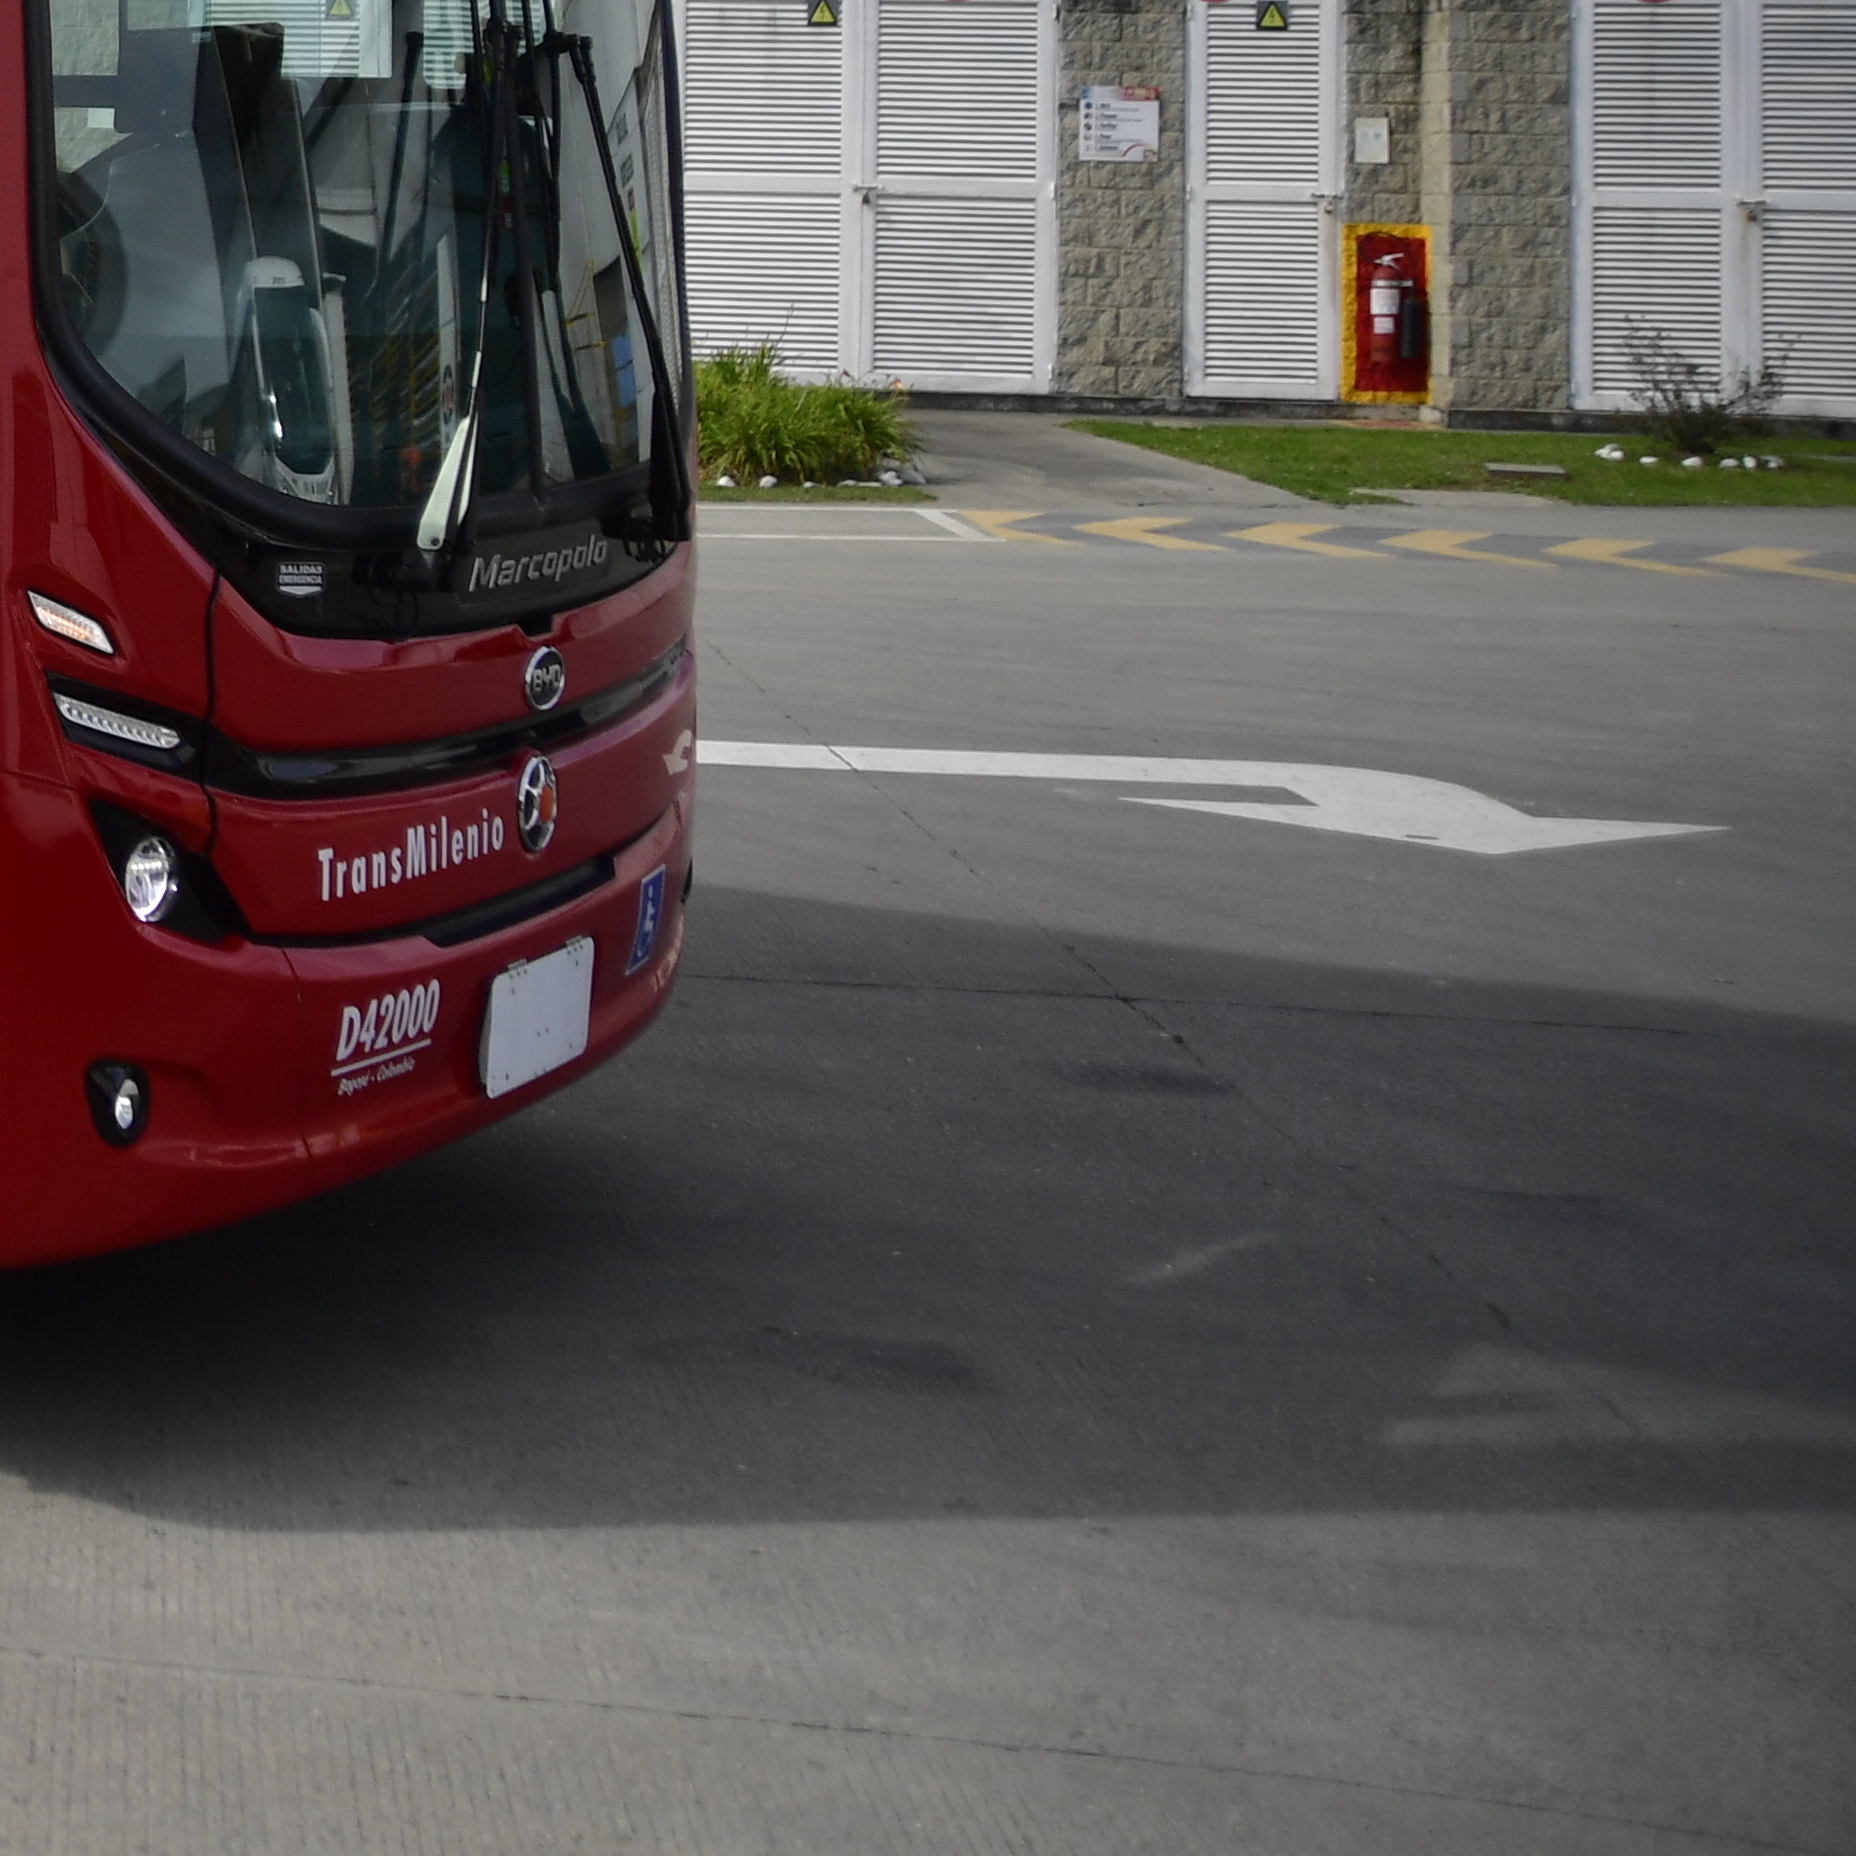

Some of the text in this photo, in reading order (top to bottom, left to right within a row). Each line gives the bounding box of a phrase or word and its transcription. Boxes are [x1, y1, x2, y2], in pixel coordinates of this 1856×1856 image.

[468, 534, 608, 592] Marcopolo
[534, 664, 562, 692] BYD
[317, 808, 504, 902] TransMilenio
[336, 978, 441, 1062] D42000
